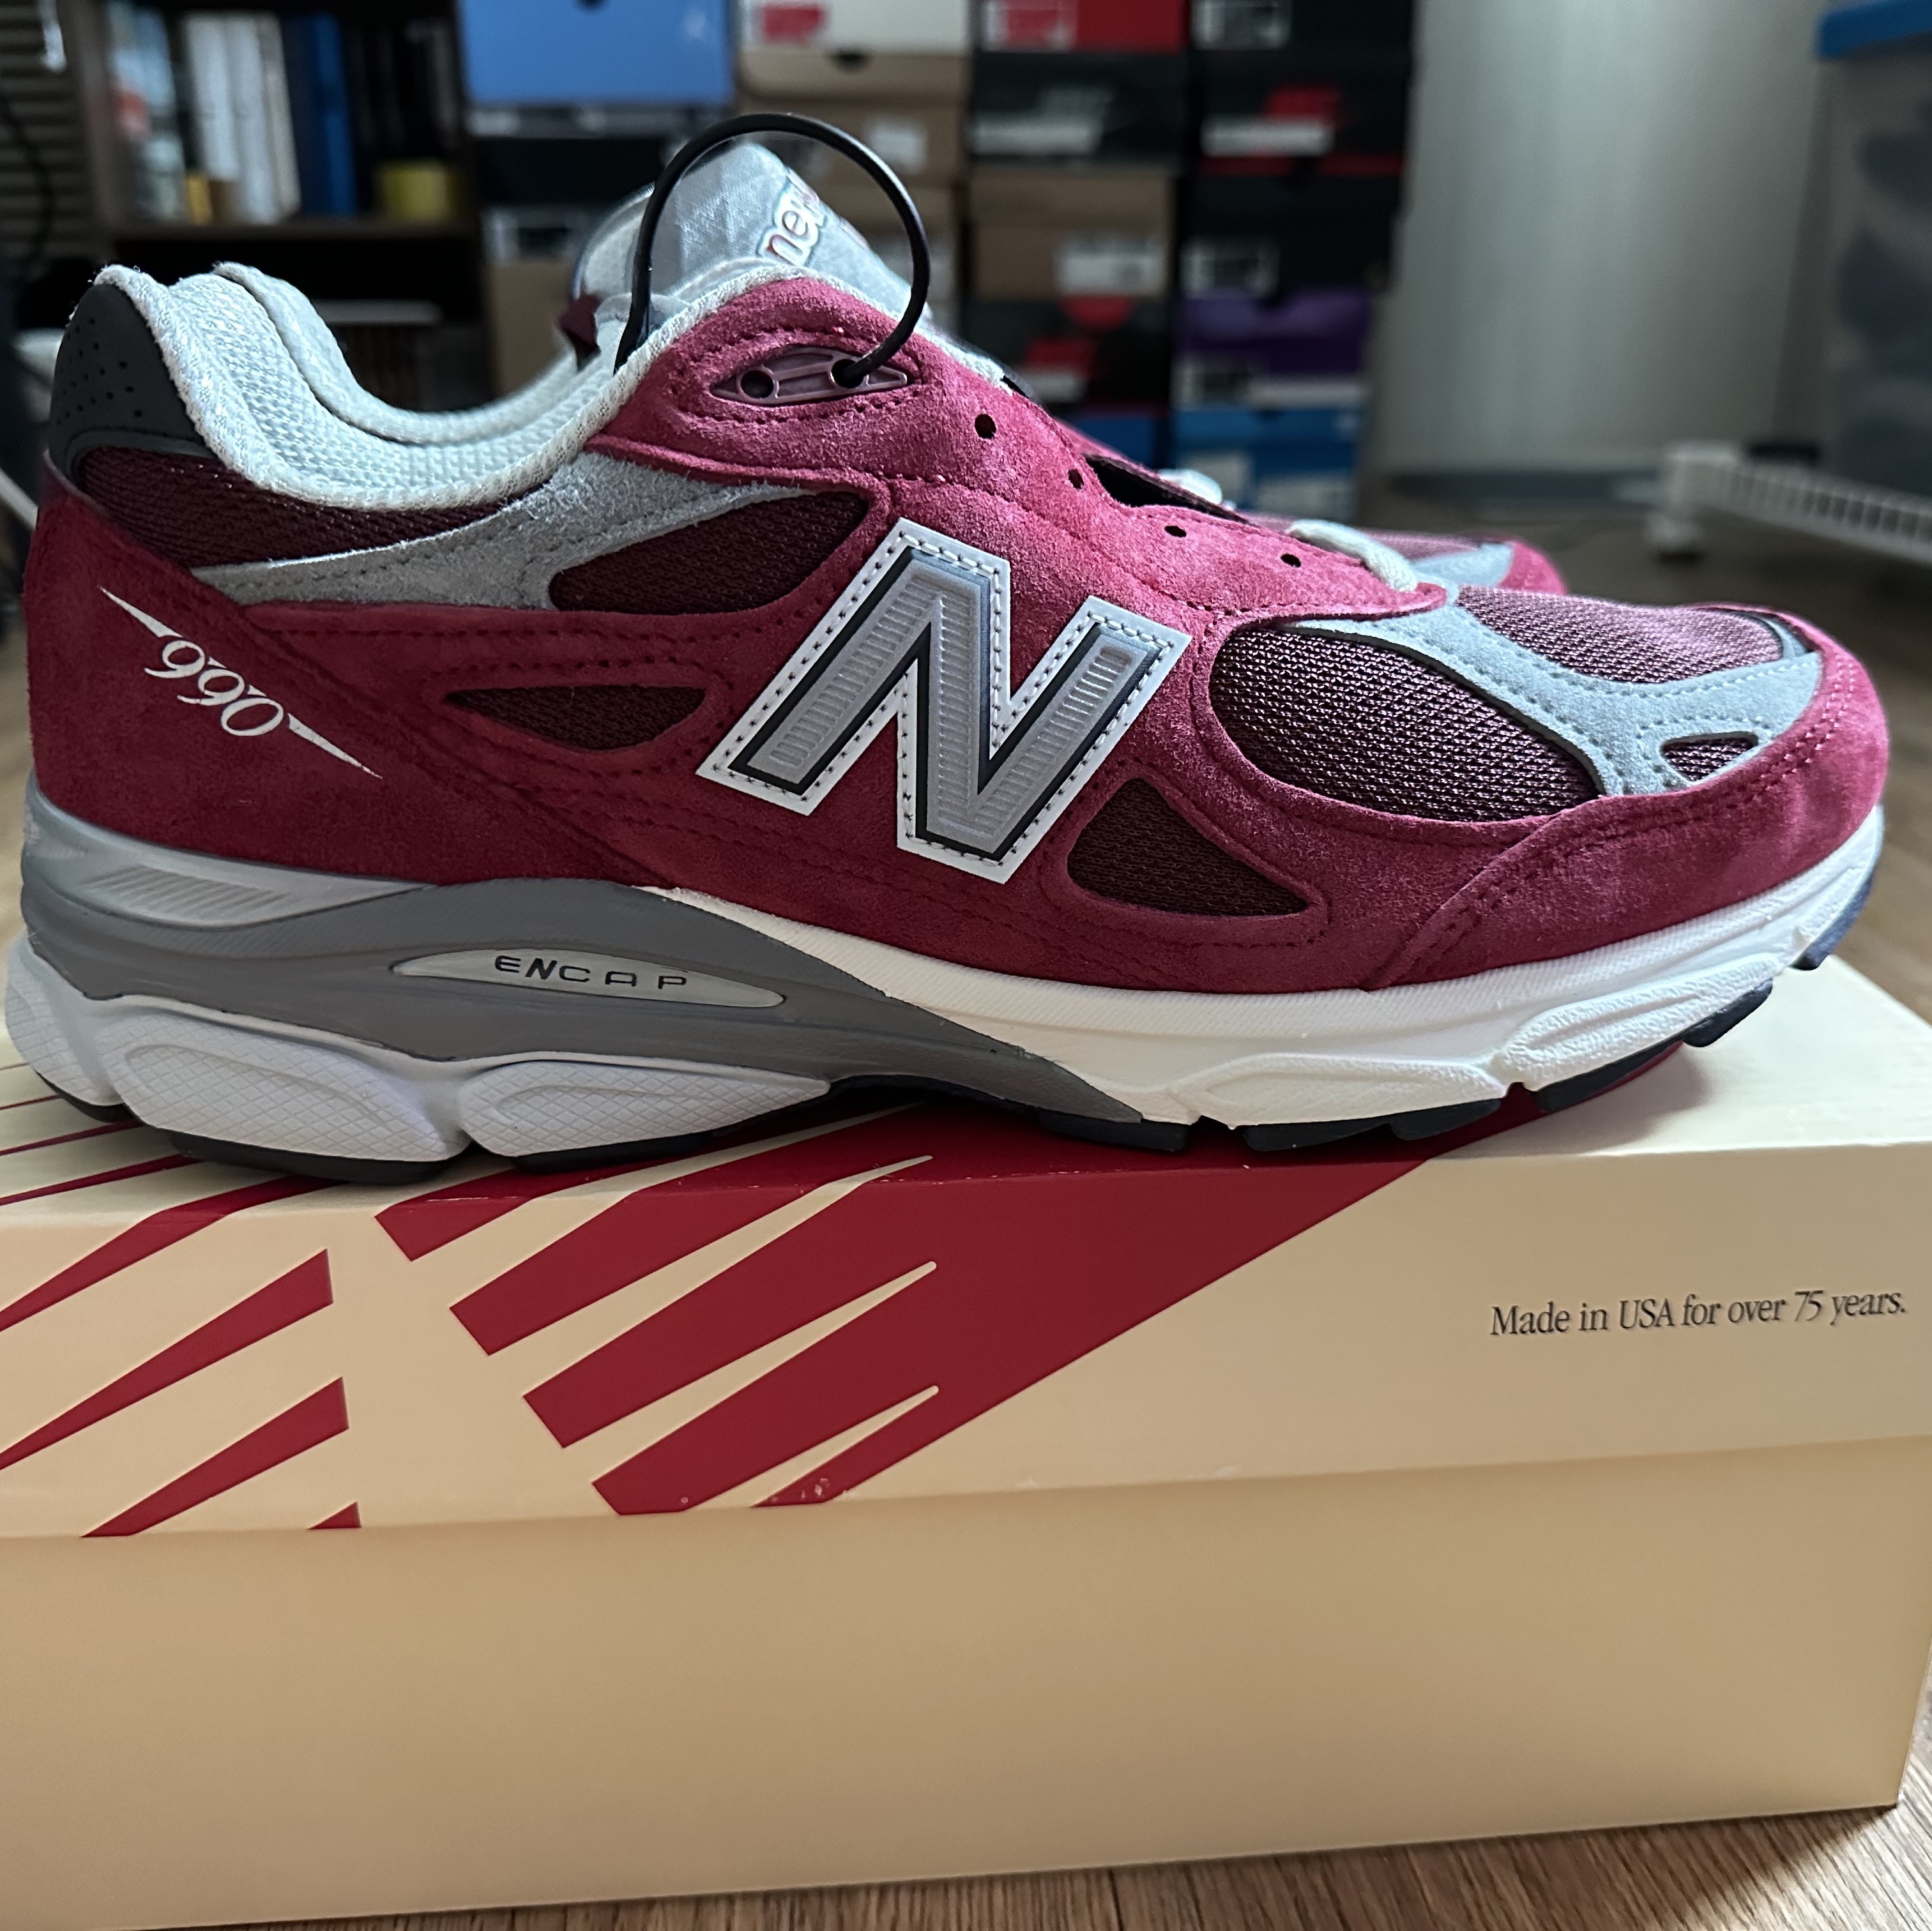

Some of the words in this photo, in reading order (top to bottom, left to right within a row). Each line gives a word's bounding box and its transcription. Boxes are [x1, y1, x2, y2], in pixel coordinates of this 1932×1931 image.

[144, 639, 285, 737] 990
[696, 518, 1192, 885] N
[494, 955, 687, 990] ENCAP
[1490, 1301, 1570, 1336] Made
[1578, 1302, 1609, 1331] in
[1618, 1298, 1675, 1329] USA
[1680, 1293, 1721, 1326] for
[1727, 1299, 1786, 1324] over
[1794, 1289, 1825, 1322] 75
[1830, 1292, 1906, 1326] years.
